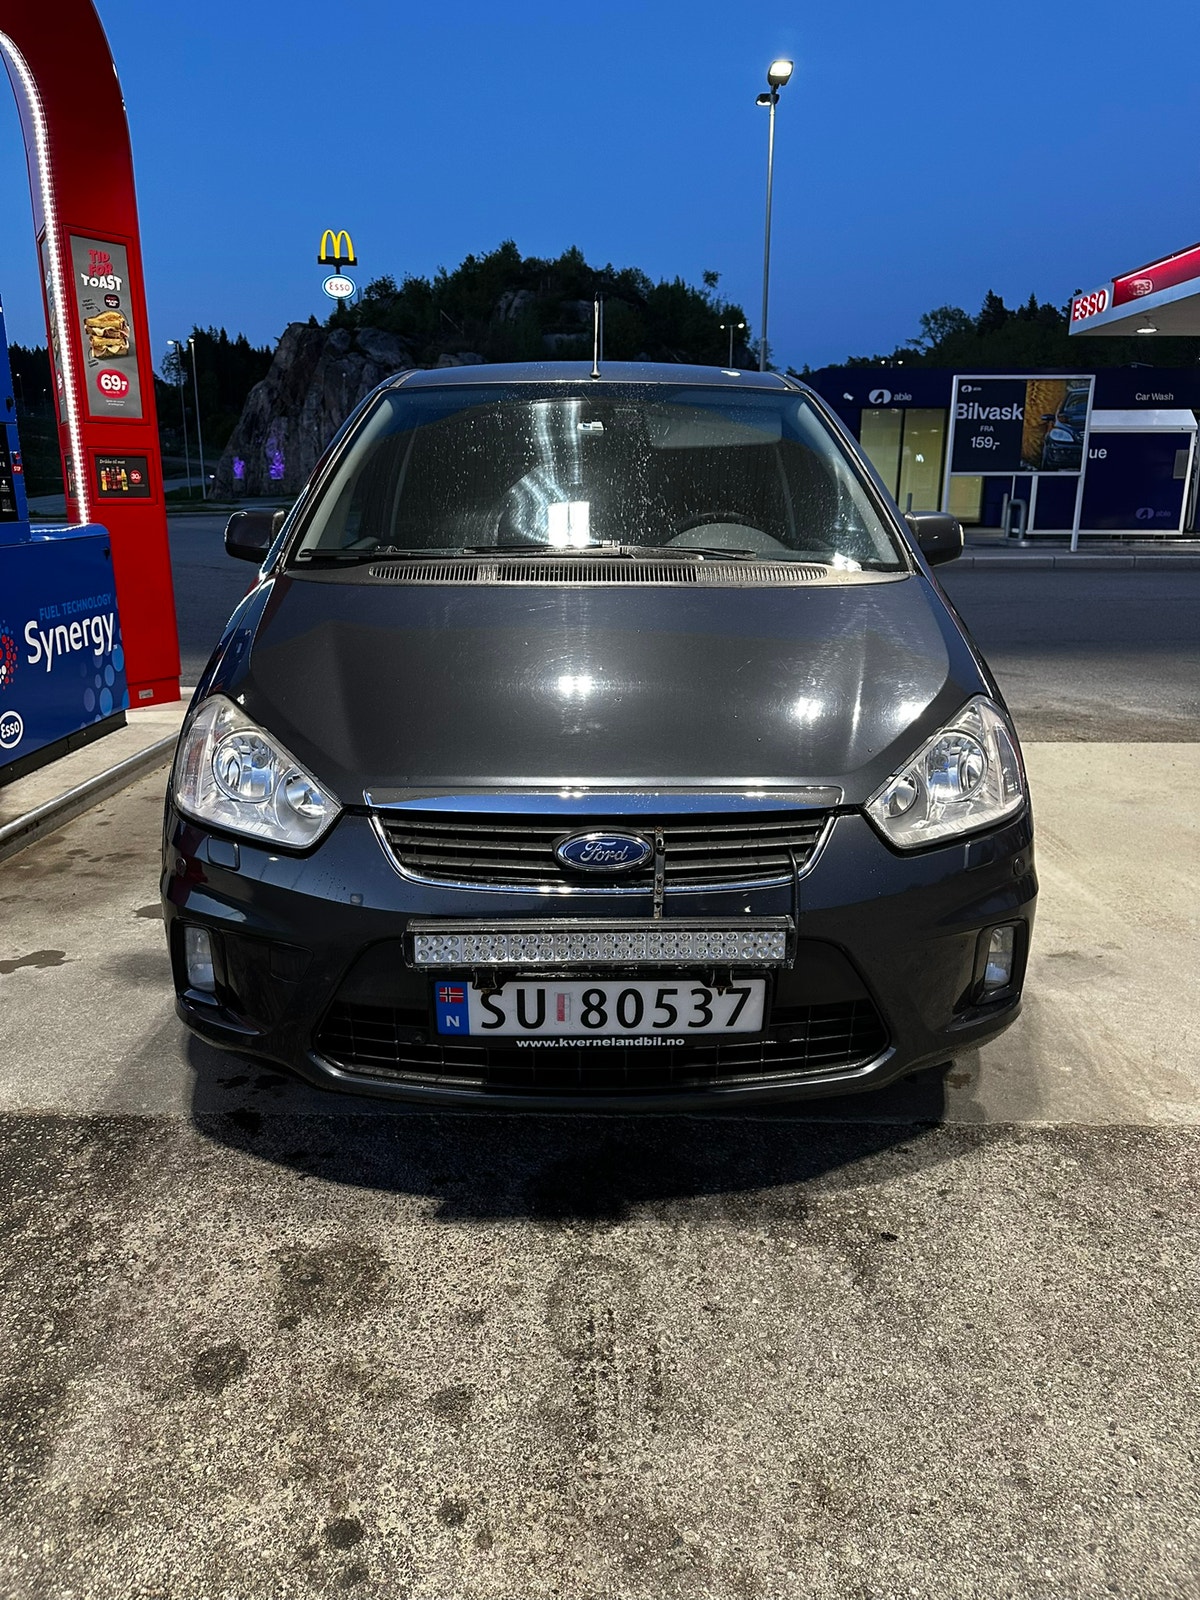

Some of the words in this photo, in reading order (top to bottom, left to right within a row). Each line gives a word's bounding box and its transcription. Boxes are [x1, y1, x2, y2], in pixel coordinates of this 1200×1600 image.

[88, 249, 110, 263] TID
[88, 262, 113, 277] FOR
[80, 273, 122, 291] TOAST
[1072, 289, 1108, 321] ESSO
[893, 392, 912, 401] able
[1135, 392, 1150, 401] Car
[1151, 392, 1174, 401] Wash
[956, 402, 1024, 420] Bilvask
[970, 436, 1000, 450] 159,-
[40, 605, 61, 621] FUEL
[62, 593, 112, 615] TECHNOLOGY
[24, 612, 114, 673] Synergy
[580, 841, 628, 862] Ford
[480, 988, 546, 1029] SU
[579, 987, 752, 1029] 80537
[446, 1016, 460, 1027] N
[516, 1037, 685, 1047] www.kvernelandbil.no
